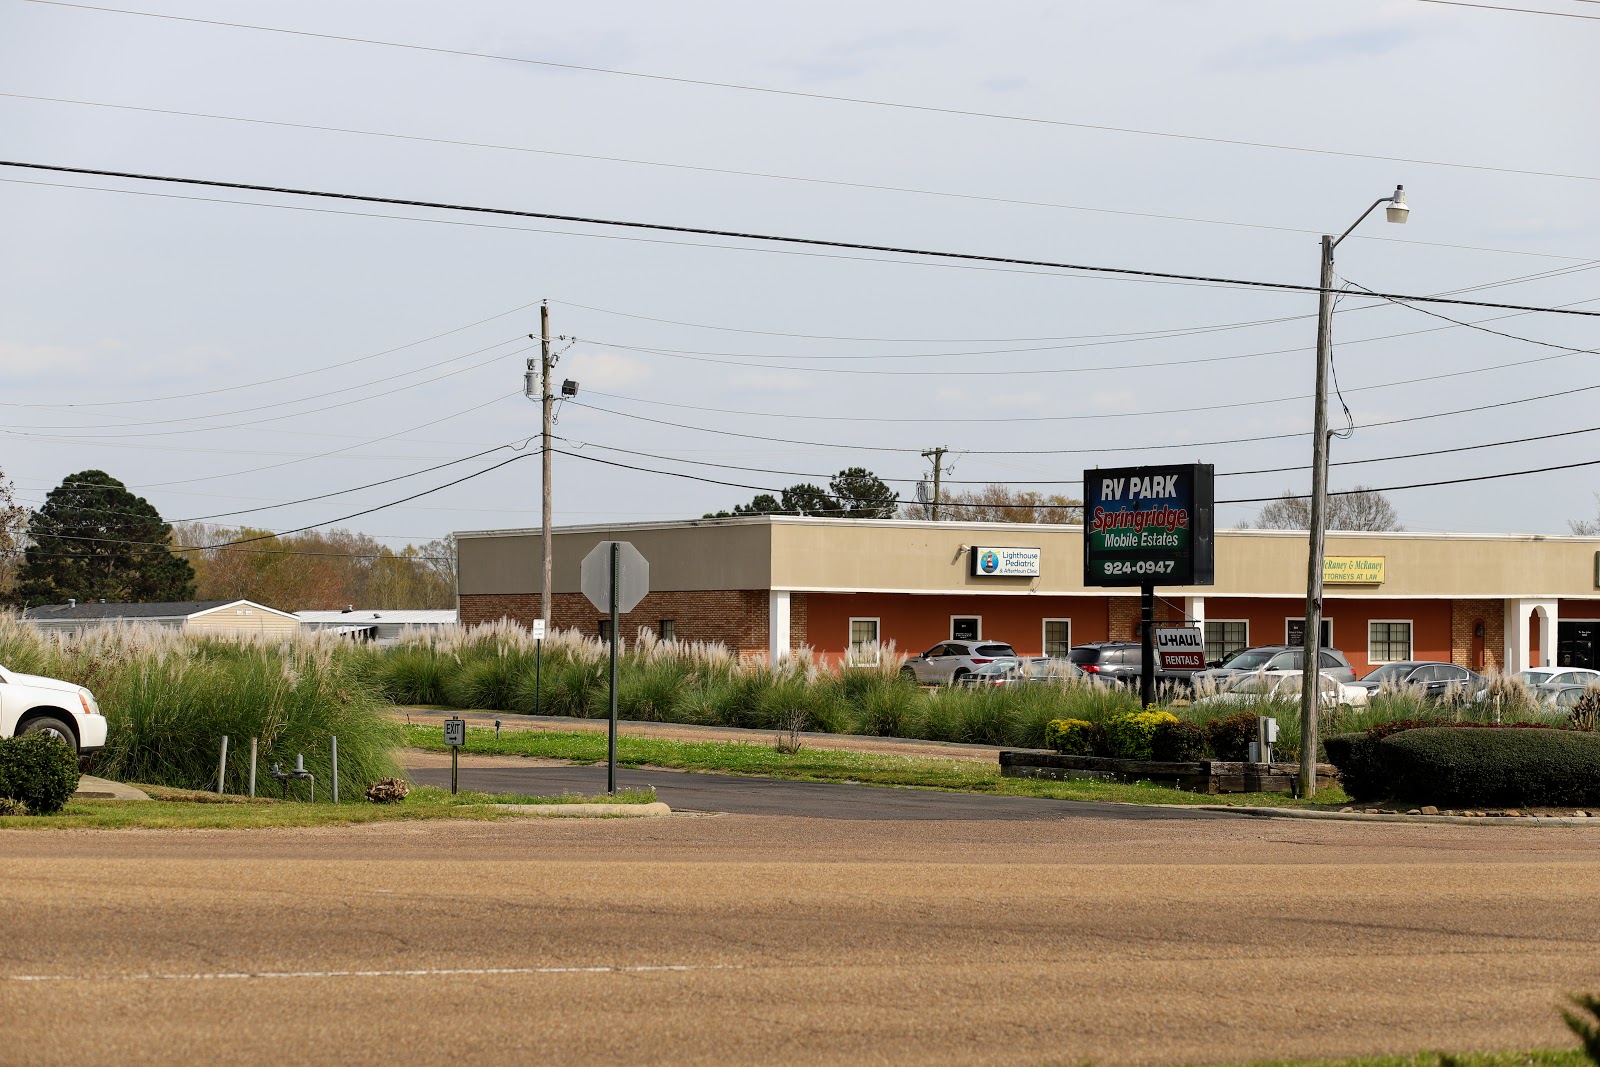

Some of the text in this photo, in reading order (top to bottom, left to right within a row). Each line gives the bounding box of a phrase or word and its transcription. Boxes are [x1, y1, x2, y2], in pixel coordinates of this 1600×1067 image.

[1101, 475, 1179, 501] RV PARK
[1093, 504, 1188, 535] Springridge
[1104, 532, 1178, 548] Mobile Estates
[1002, 551, 1038, 559] Lighthouse
[1103, 561, 1175, 575] 924-0947
[1348, 560, 1354, 569] &
[1355, 560, 1382, 573] McRaney
[1158, 634, 1201, 647] U-HAUL
[1165, 655, 1200, 665] RENTALS
[446, 723, 460, 734] EXIT
